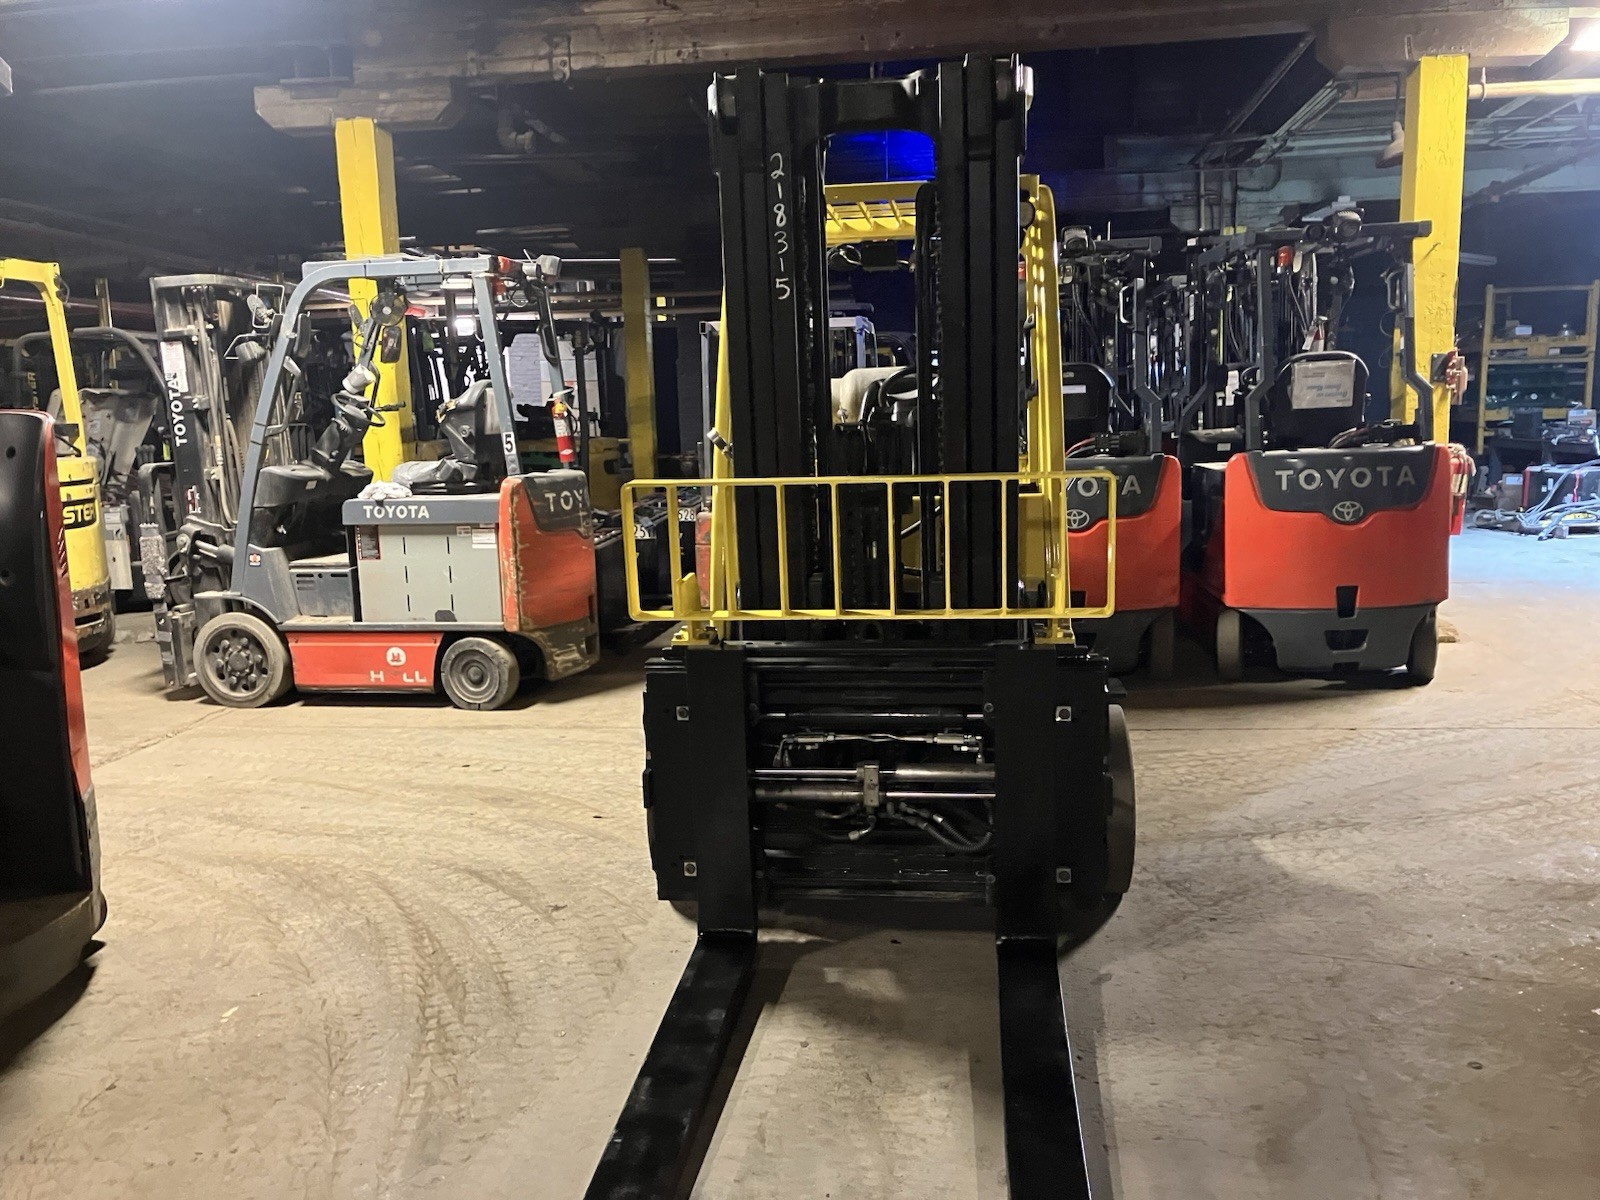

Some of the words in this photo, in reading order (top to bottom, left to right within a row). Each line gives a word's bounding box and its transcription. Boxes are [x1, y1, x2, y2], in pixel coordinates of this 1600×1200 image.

[770, 152, 791, 300] 218315
[167, 375, 188, 447] TOYOTA
[505, 434, 513, 453] 5
[1275, 465, 1416, 491] TOYOTA
[362, 505, 430, 519] TOYOTA
[544, 489, 583, 512] TOY
